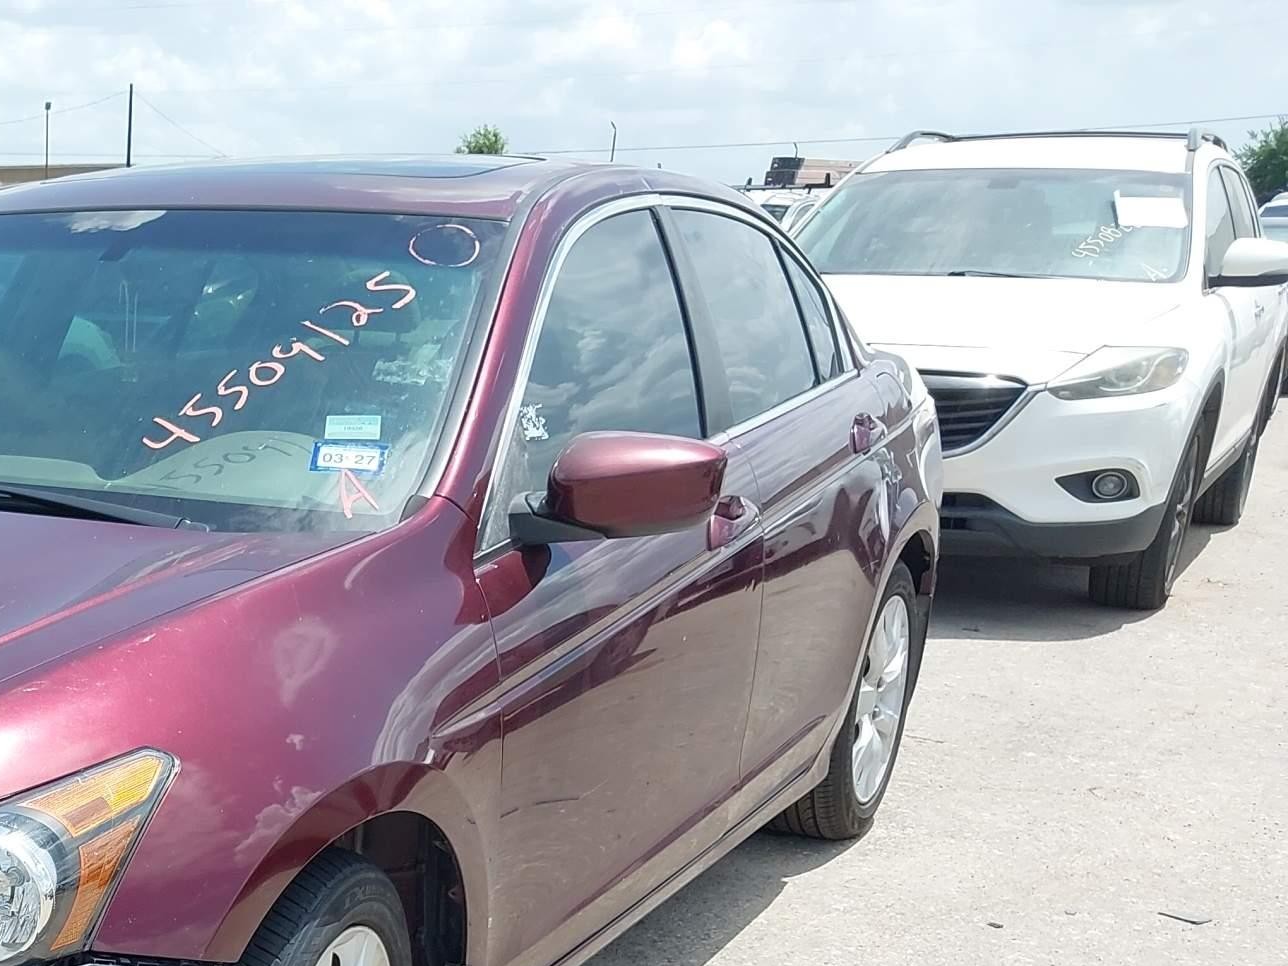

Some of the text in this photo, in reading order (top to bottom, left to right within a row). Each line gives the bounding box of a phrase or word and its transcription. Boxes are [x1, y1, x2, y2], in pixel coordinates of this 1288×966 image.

[142, 270, 417, 449] 45509125
[322, 452, 377, 466] 03 27
